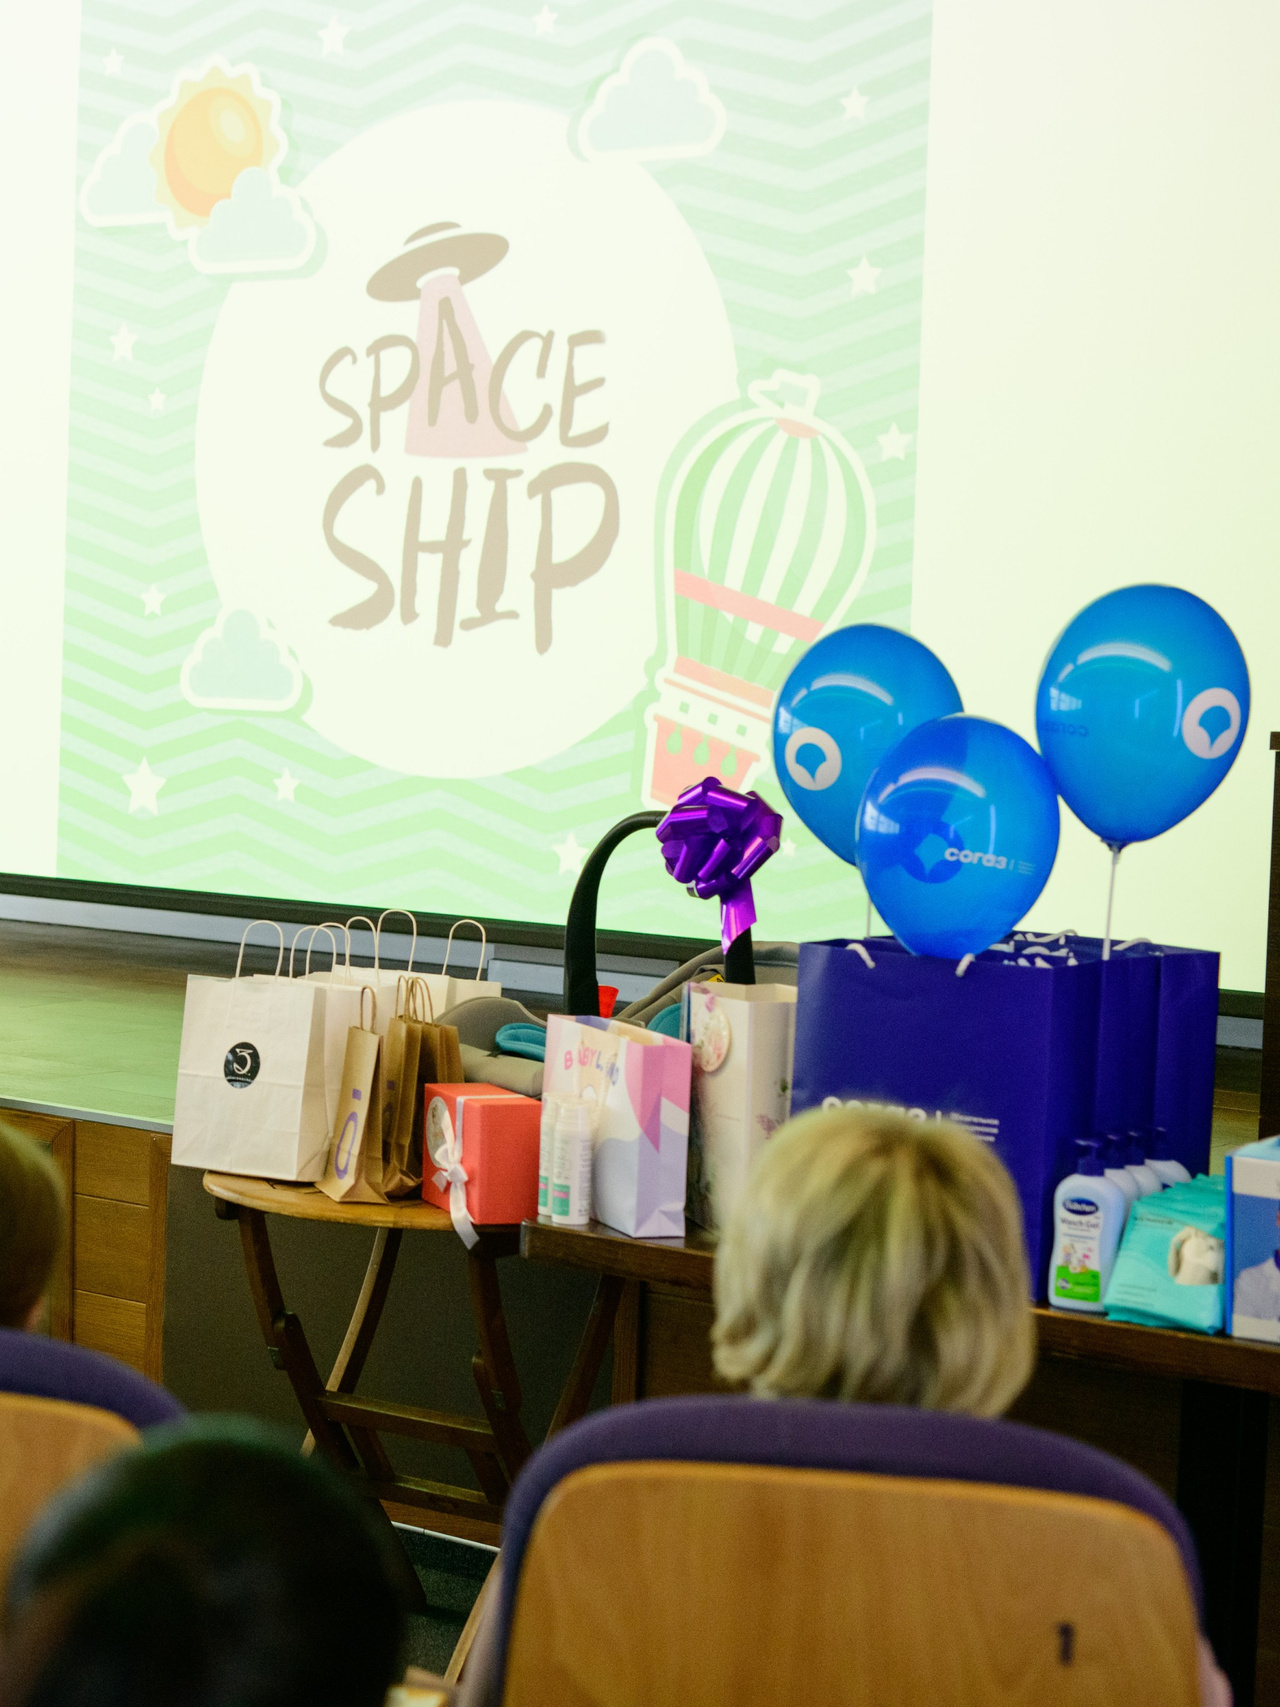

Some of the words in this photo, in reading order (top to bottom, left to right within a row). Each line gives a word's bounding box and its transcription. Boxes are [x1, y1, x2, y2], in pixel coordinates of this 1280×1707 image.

[320, 296, 609, 453] SPACE
[323, 462, 620, 655] SHIP
[1058, 1623, 1074, 1667] 1
